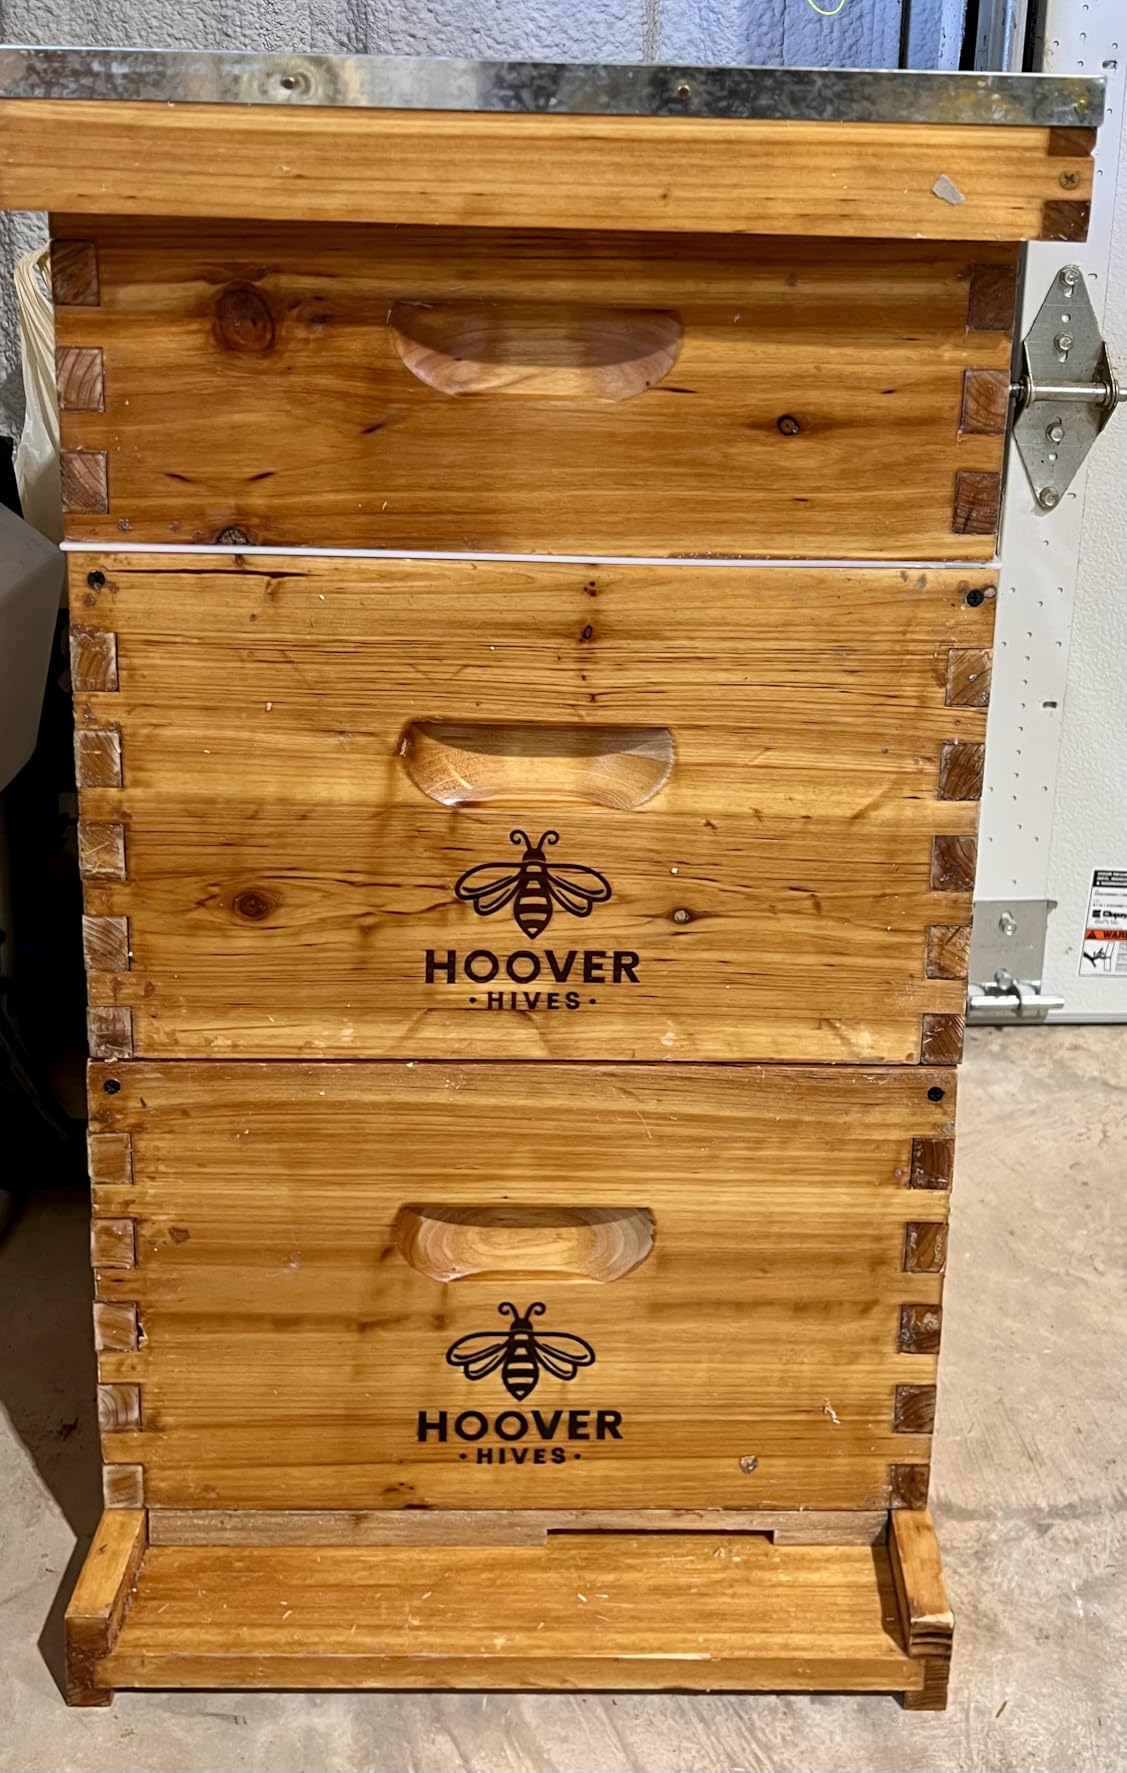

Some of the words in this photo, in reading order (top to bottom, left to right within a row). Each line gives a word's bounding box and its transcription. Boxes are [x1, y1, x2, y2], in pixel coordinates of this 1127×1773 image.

[425, 949, 641, 984] HOOVER
[487, 991, 580, 1010] HIVES
[417, 1410, 624, 1442] HOOVER
[476, 1447, 566, 1464] HIVES
